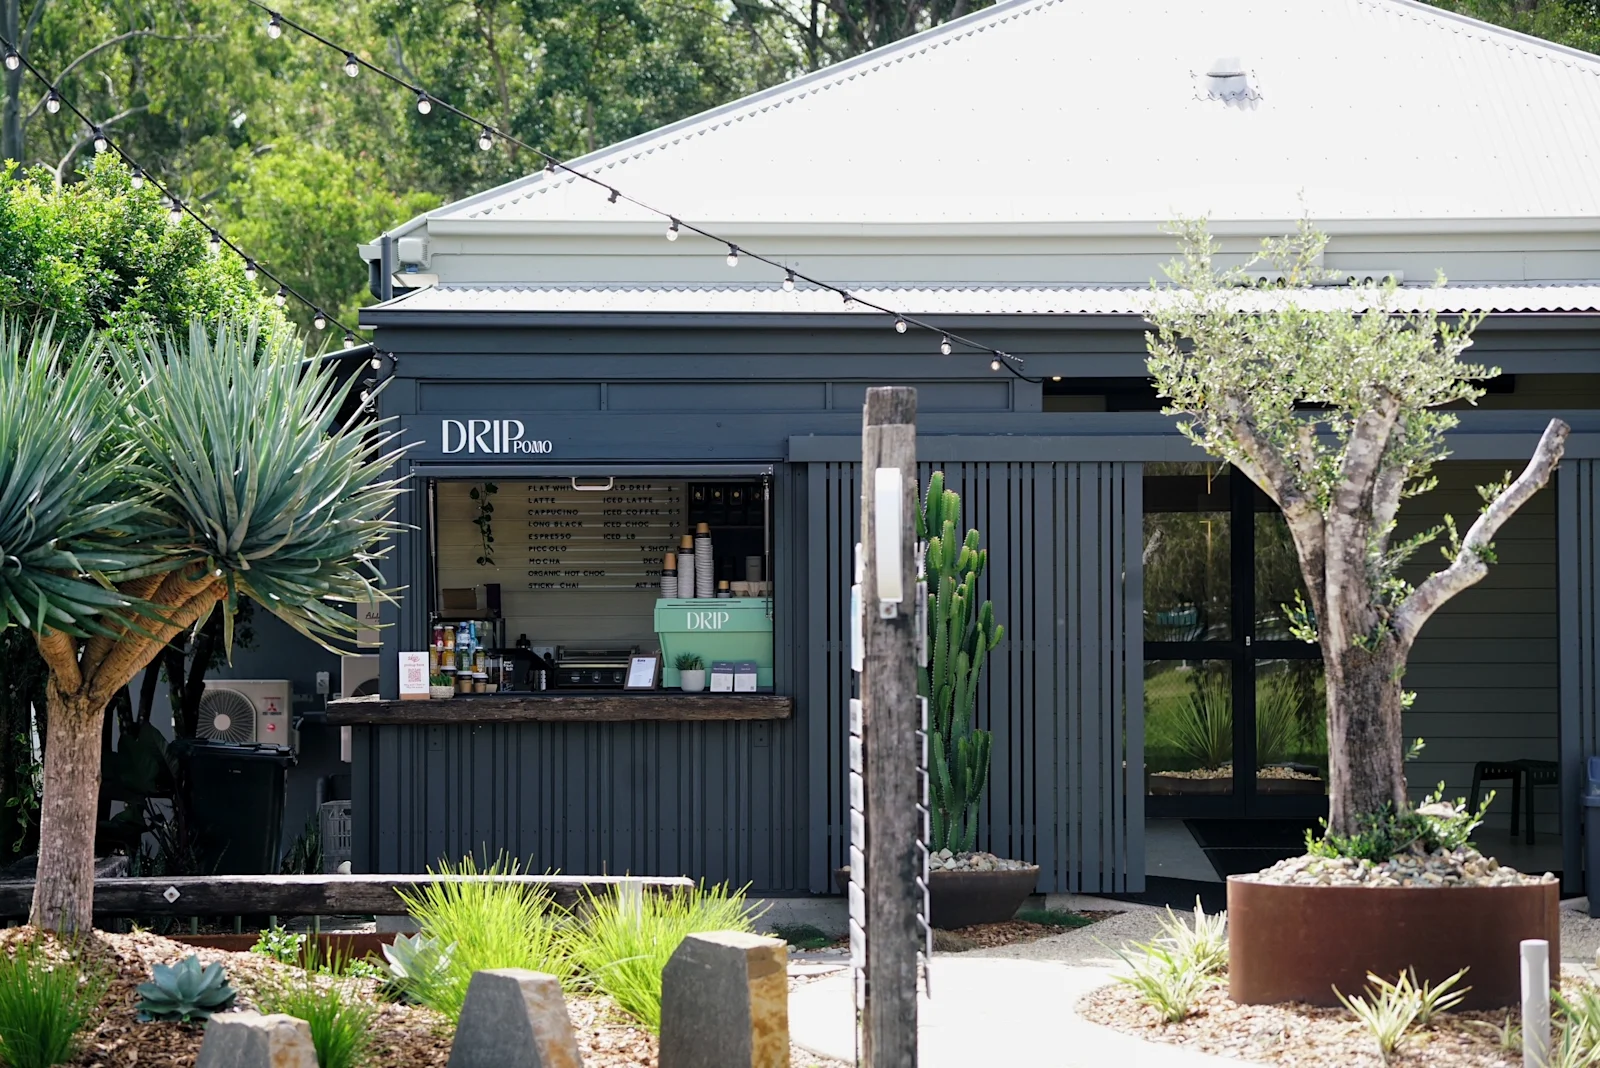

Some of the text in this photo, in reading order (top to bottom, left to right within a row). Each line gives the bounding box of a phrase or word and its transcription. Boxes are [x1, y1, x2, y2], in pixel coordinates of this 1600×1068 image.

[442, 419, 552, 453] DRIP POMO
[687, 611, 729, 630] DRIP
